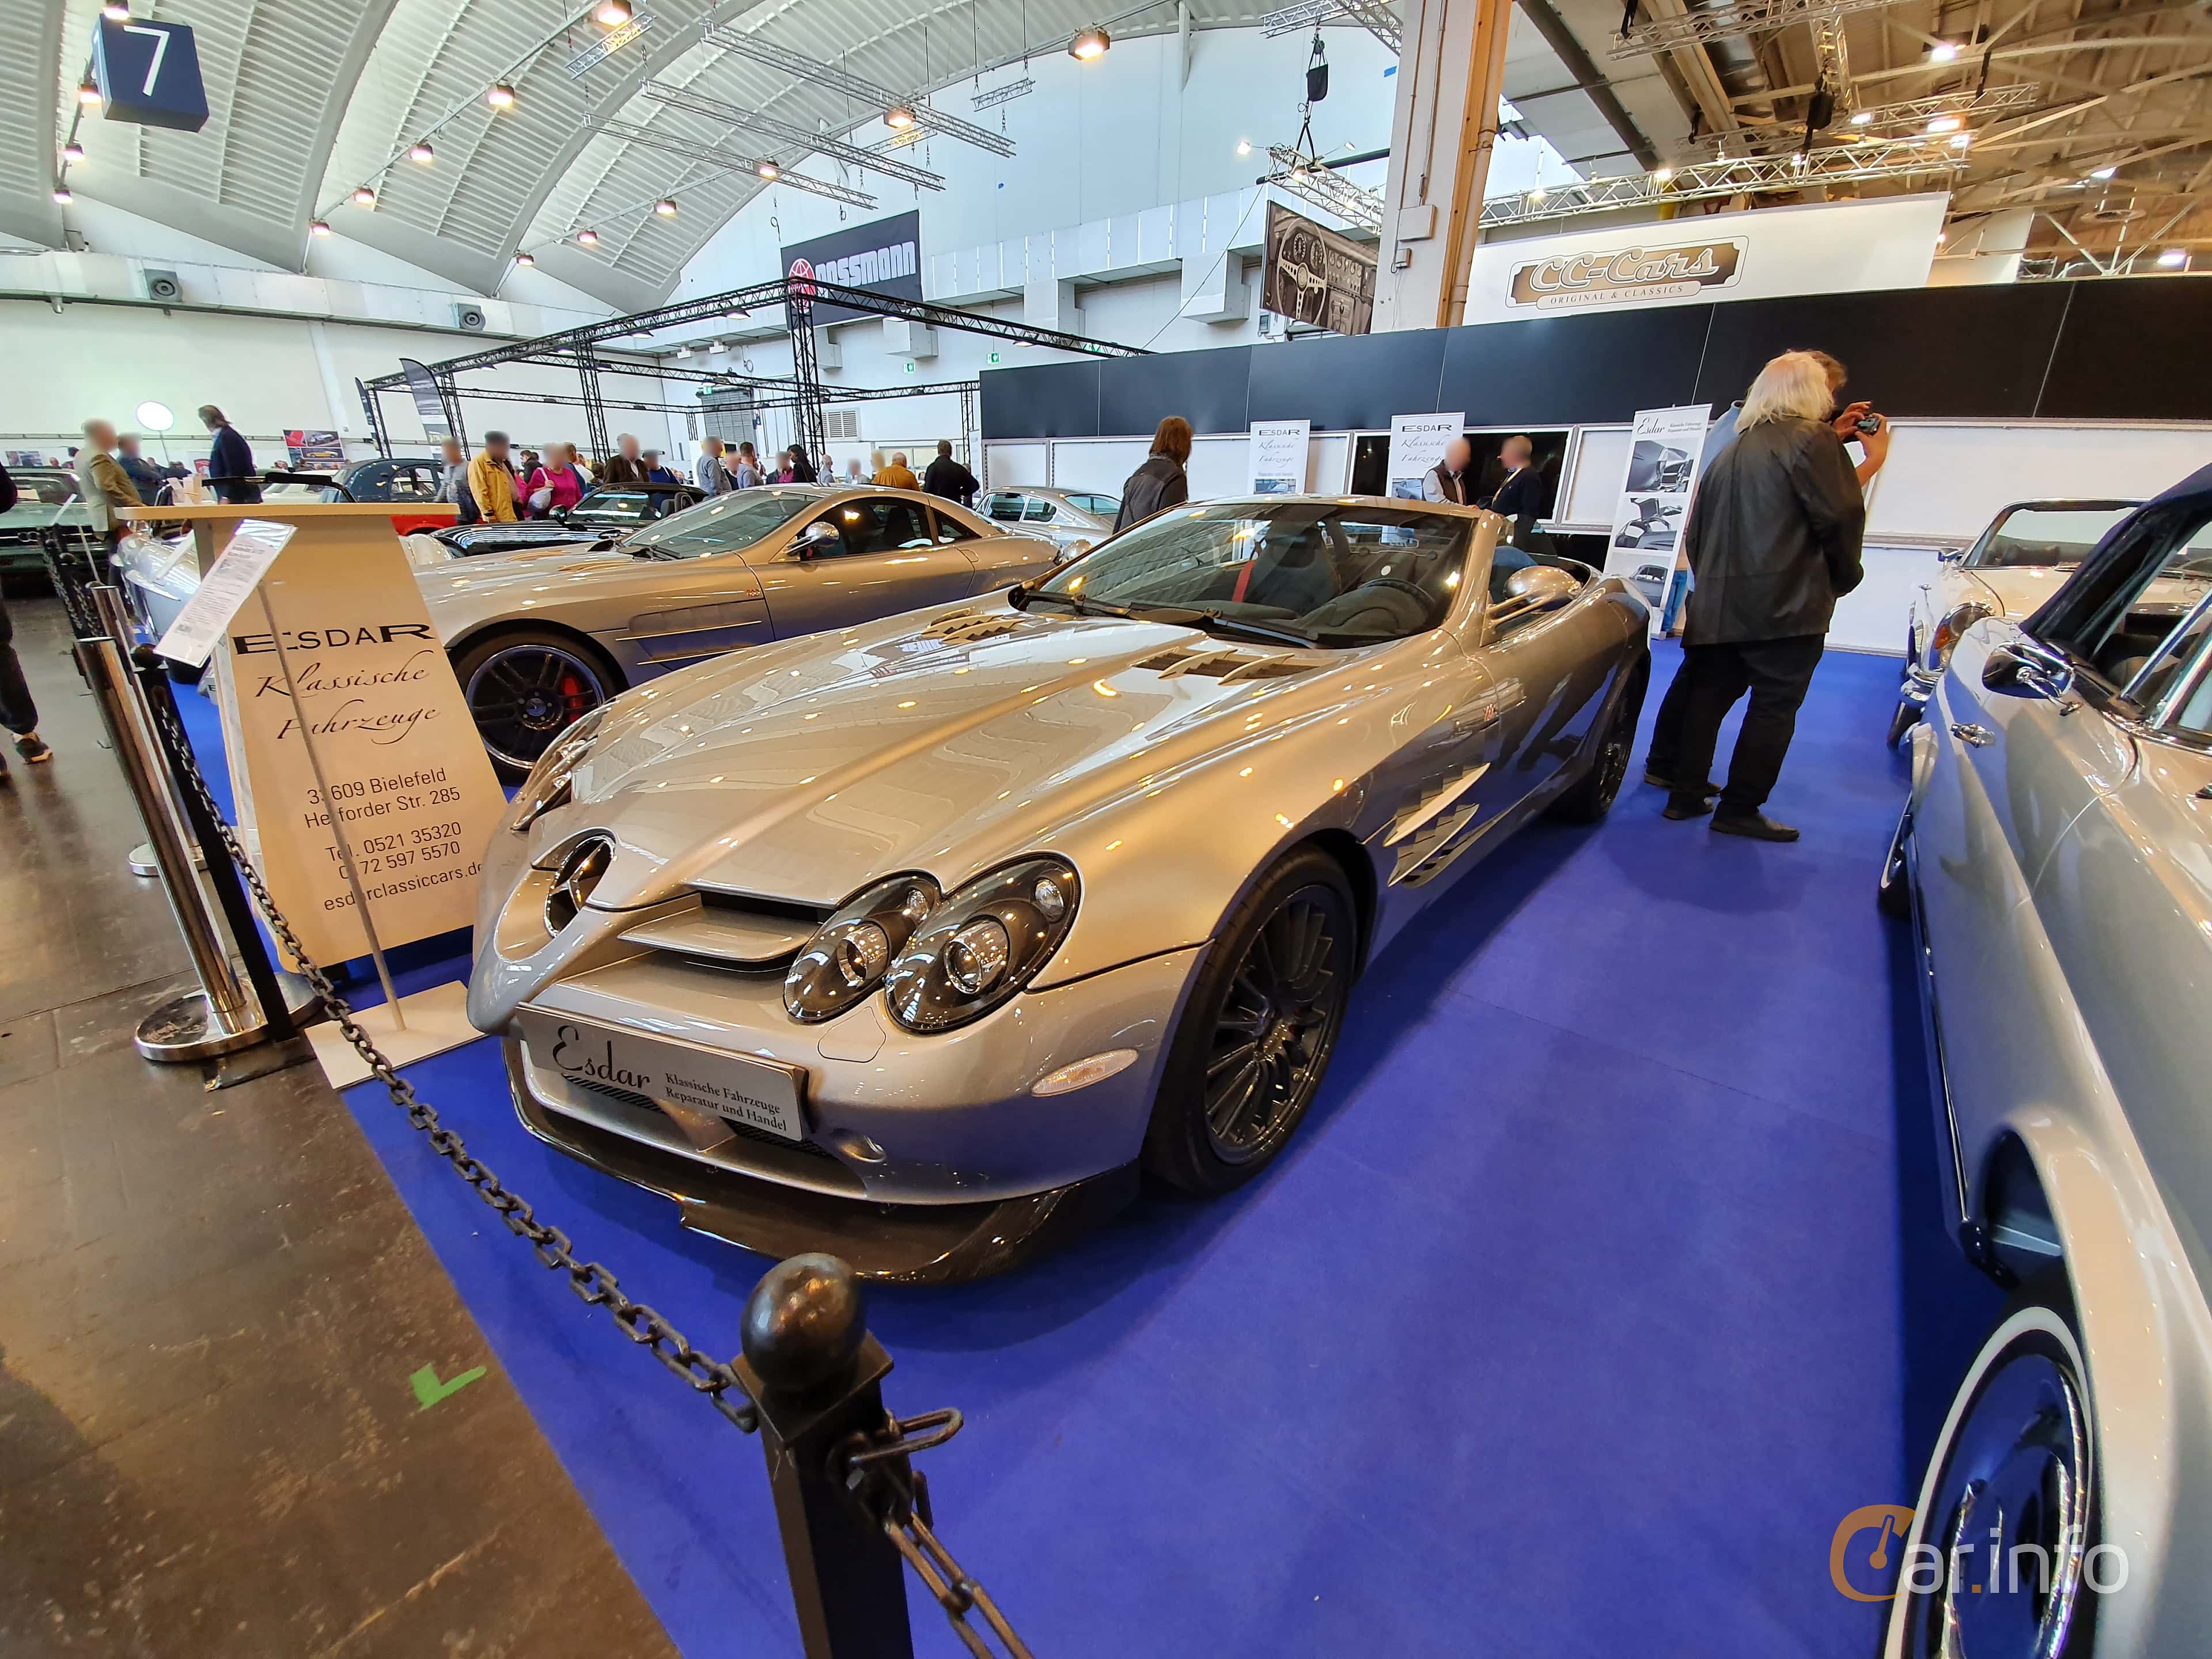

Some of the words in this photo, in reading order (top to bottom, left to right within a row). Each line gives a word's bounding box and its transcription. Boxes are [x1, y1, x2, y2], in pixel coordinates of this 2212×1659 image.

[123, 25, 171, 97] 7
[1531, 248, 1719, 292] CC-Cars
[1551, 293, 1605, 305] ORIGINAL
[1624, 285, 1683, 297] CLASSICS
[1401, 424, 1452, 432] ESDAR
[1637, 416, 1665, 435] Esdar
[232, 624, 437, 655] ESDAR
[255, 650, 434, 698] Klassische
[307, 782, 365, 804] 3609
[369, 767, 446, 793] Bielefeld
[305, 802, 391, 828] Heforder
[396, 794, 425, 810] Str.
[429, 787, 460, 805] 285
[363, 834, 404, 854] 0521
[411, 821, 461, 843] 35320
[339, 858, 382, 879] 072
[386, 850, 415, 869] 597
[421, 841, 460, 861] 5570
[324, 861, 483, 910] esdrclassiccars.d
[552, 1025, 650, 1088] Esdar
[665, 1073, 720, 1096] Klassische
[722, 1087, 781, 1115] Fahrzeuge
[665, 1086, 719, 1110] Reparatur
[722, 1105, 744, 1118] und
[746, 1109, 787, 1131] Handel
